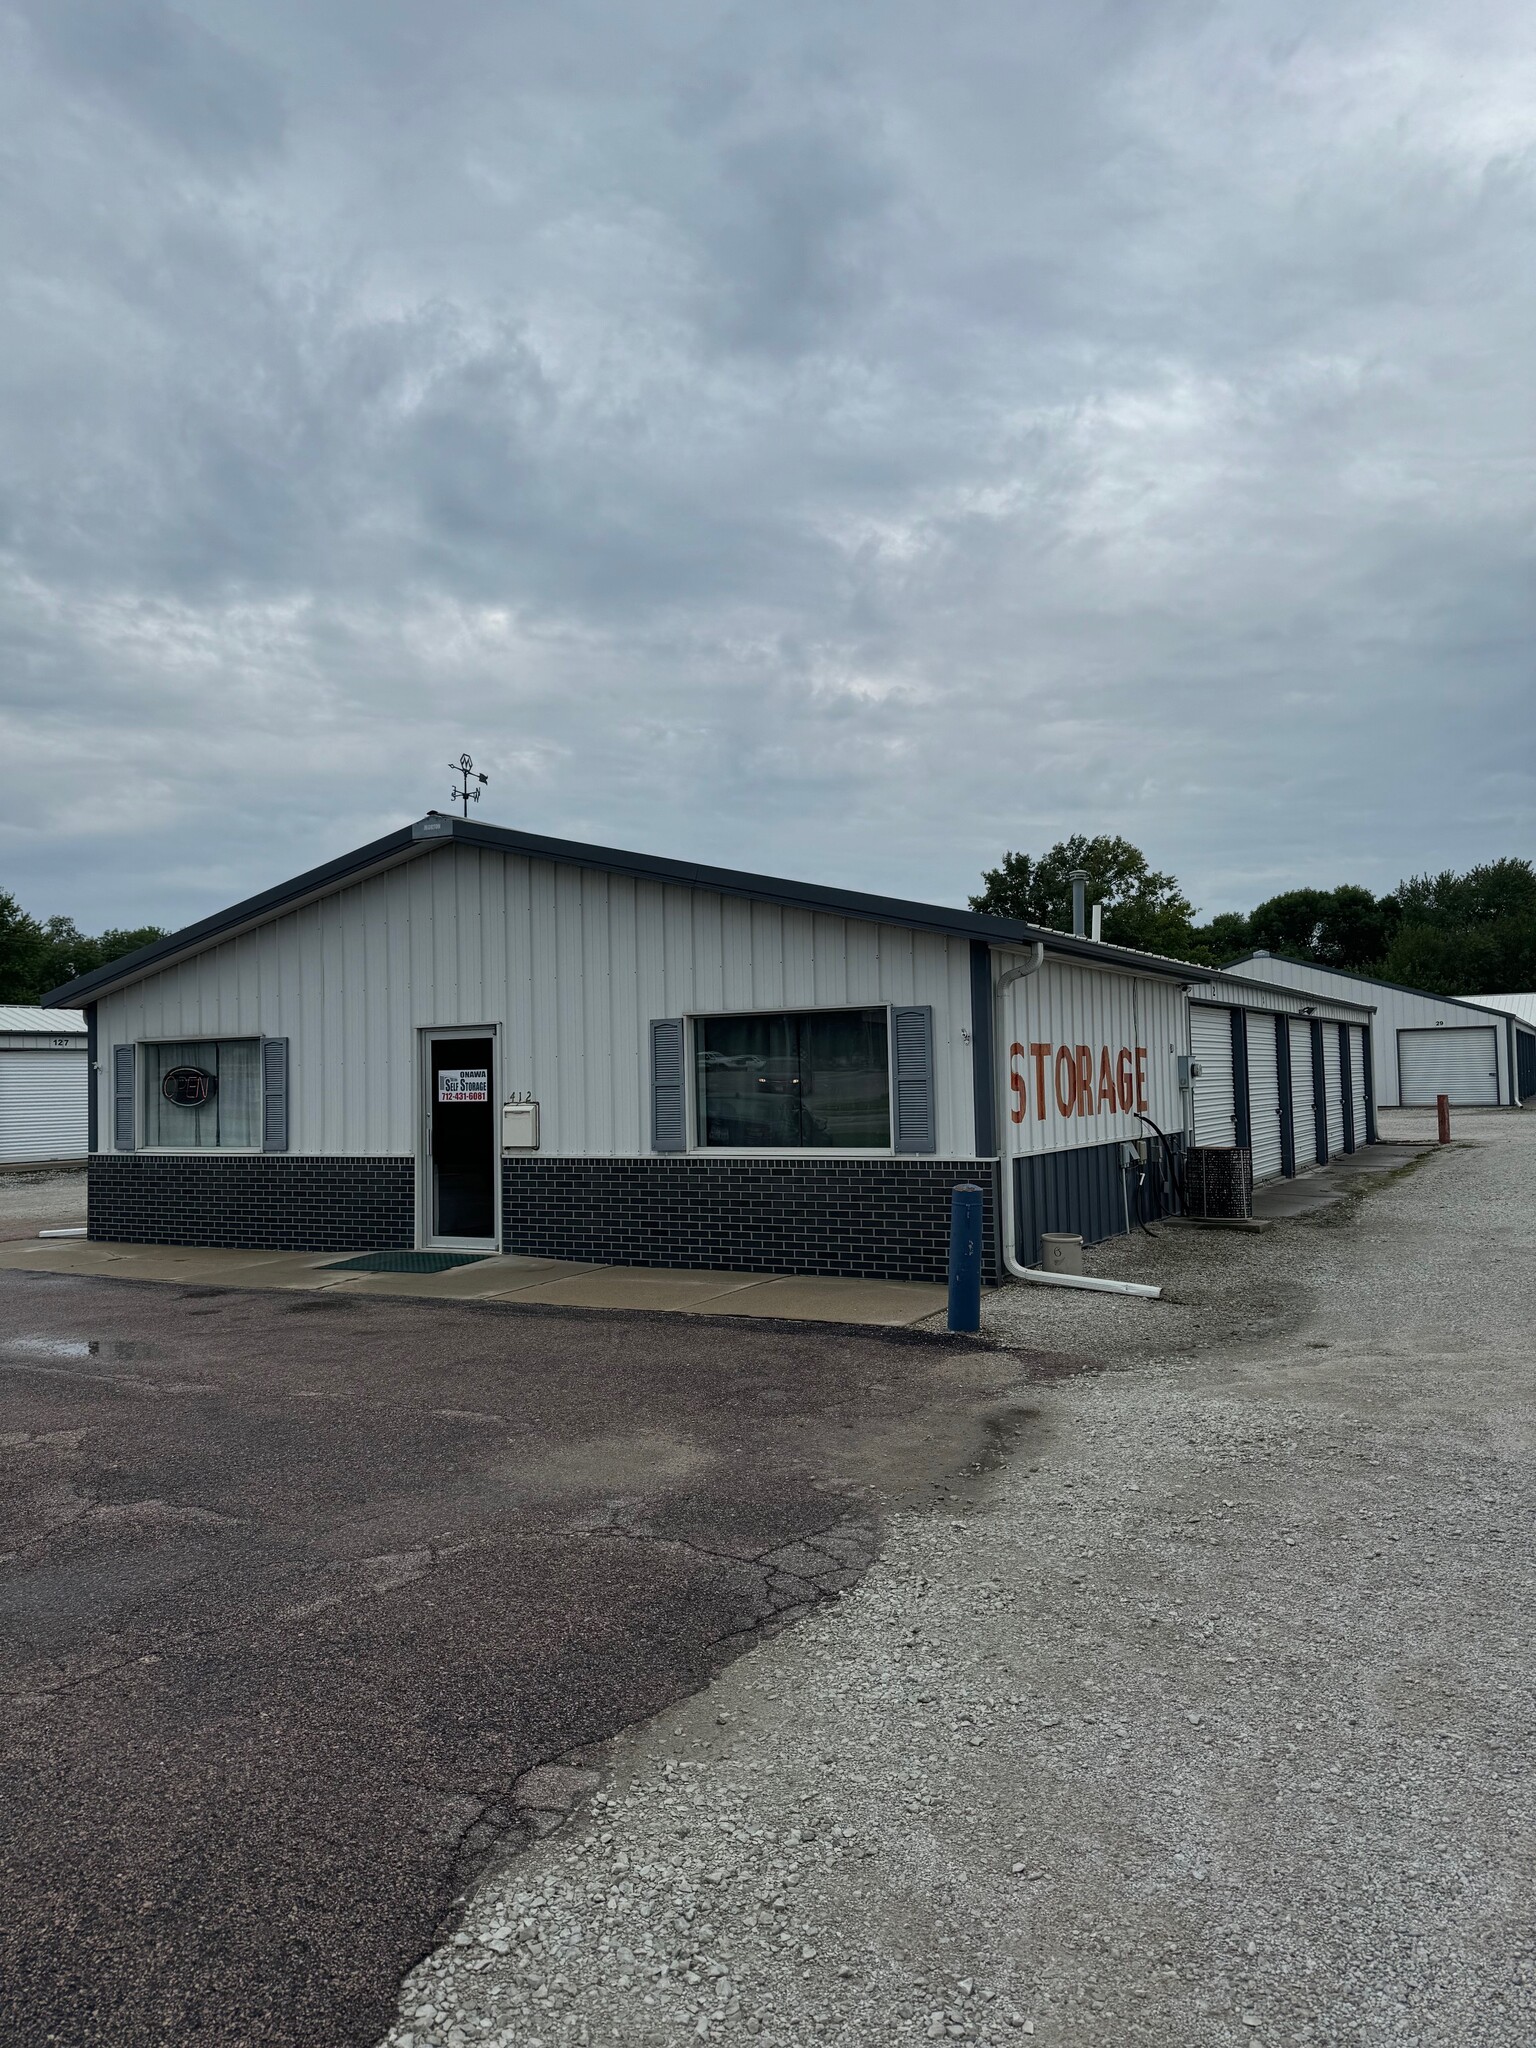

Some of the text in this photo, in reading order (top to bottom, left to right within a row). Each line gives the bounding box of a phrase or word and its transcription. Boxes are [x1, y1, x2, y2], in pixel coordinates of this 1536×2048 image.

[164, 1076, 209, 1099] OPEN
[445, 1078, 486, 1092] SELF STORAGE
[1010, 1042, 1148, 1124] STORAGE
[442, 1092, 486, 1101] 712-431-6081
[510, 1091, 532, 1103] 412
[1053, 1246, 1062, 1257] 6
